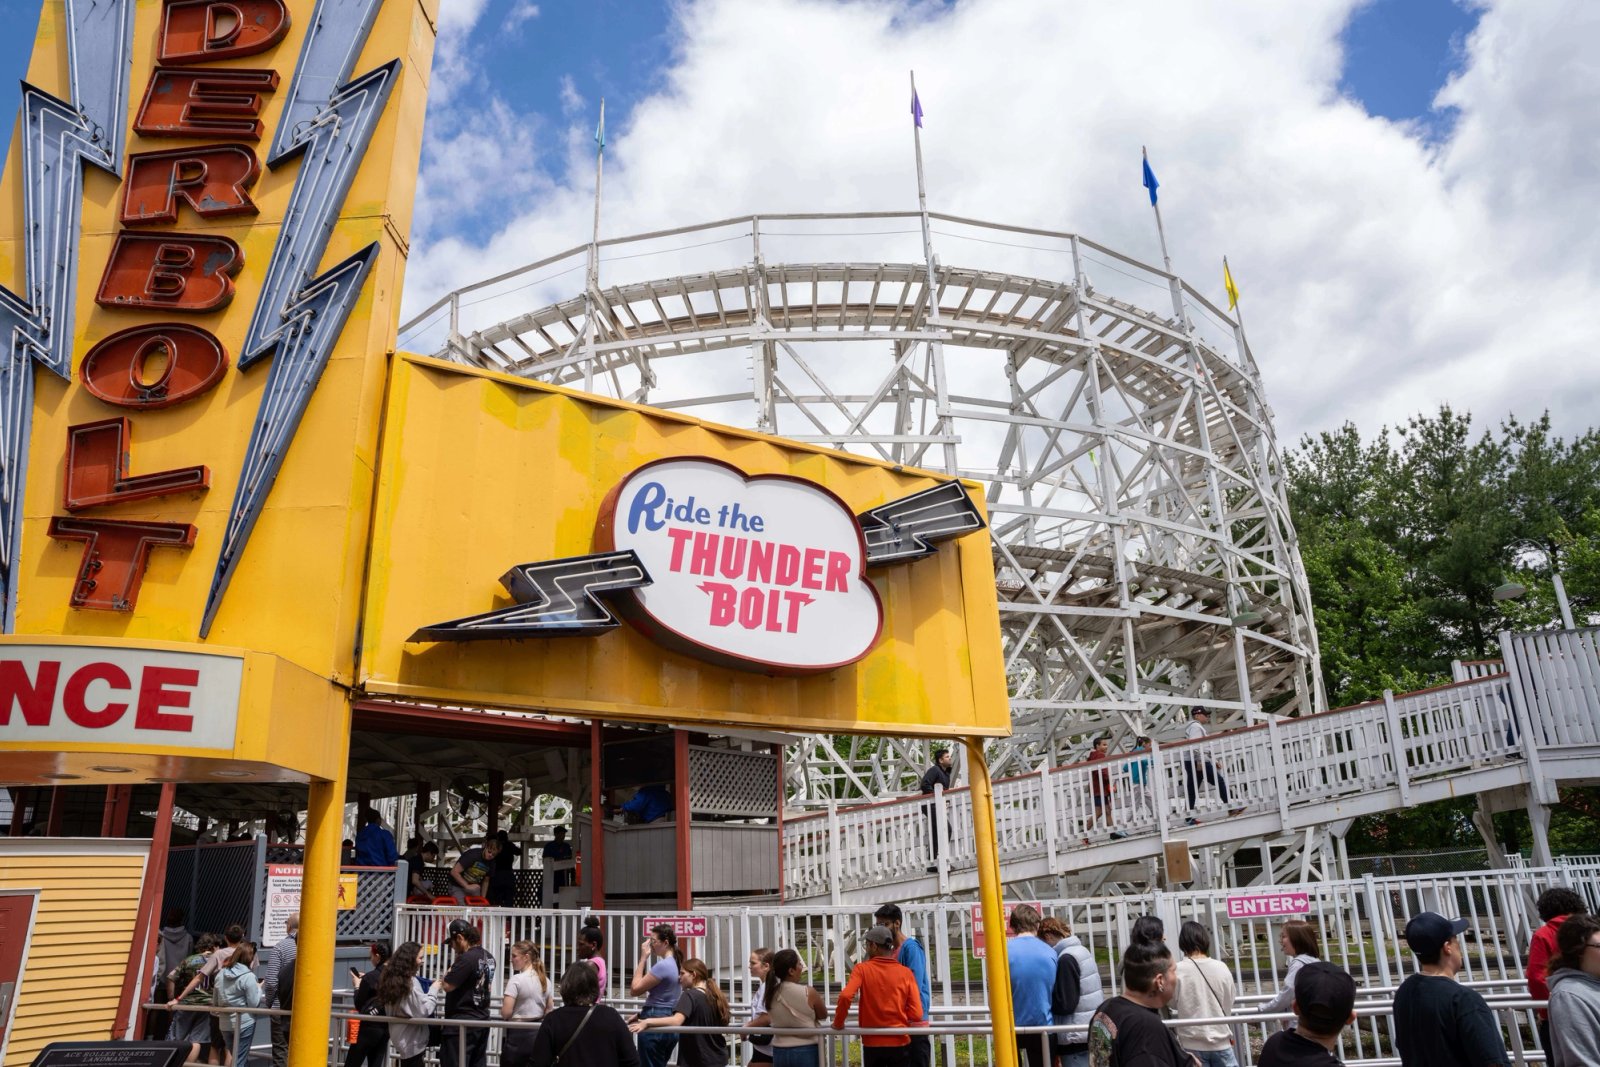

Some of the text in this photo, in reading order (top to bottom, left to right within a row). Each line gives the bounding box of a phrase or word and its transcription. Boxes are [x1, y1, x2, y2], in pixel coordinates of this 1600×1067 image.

[627, 481, 764, 534] Ride the
[667, 527, 851, 593] THUNDER
[696, 581, 816, 633] BOLT
[0, 660, 200, 733] NCE
[275, 867, 304, 875] NOTI
[646, 921, 694, 934] EER
[1230, 897, 1295, 915] ENTER
